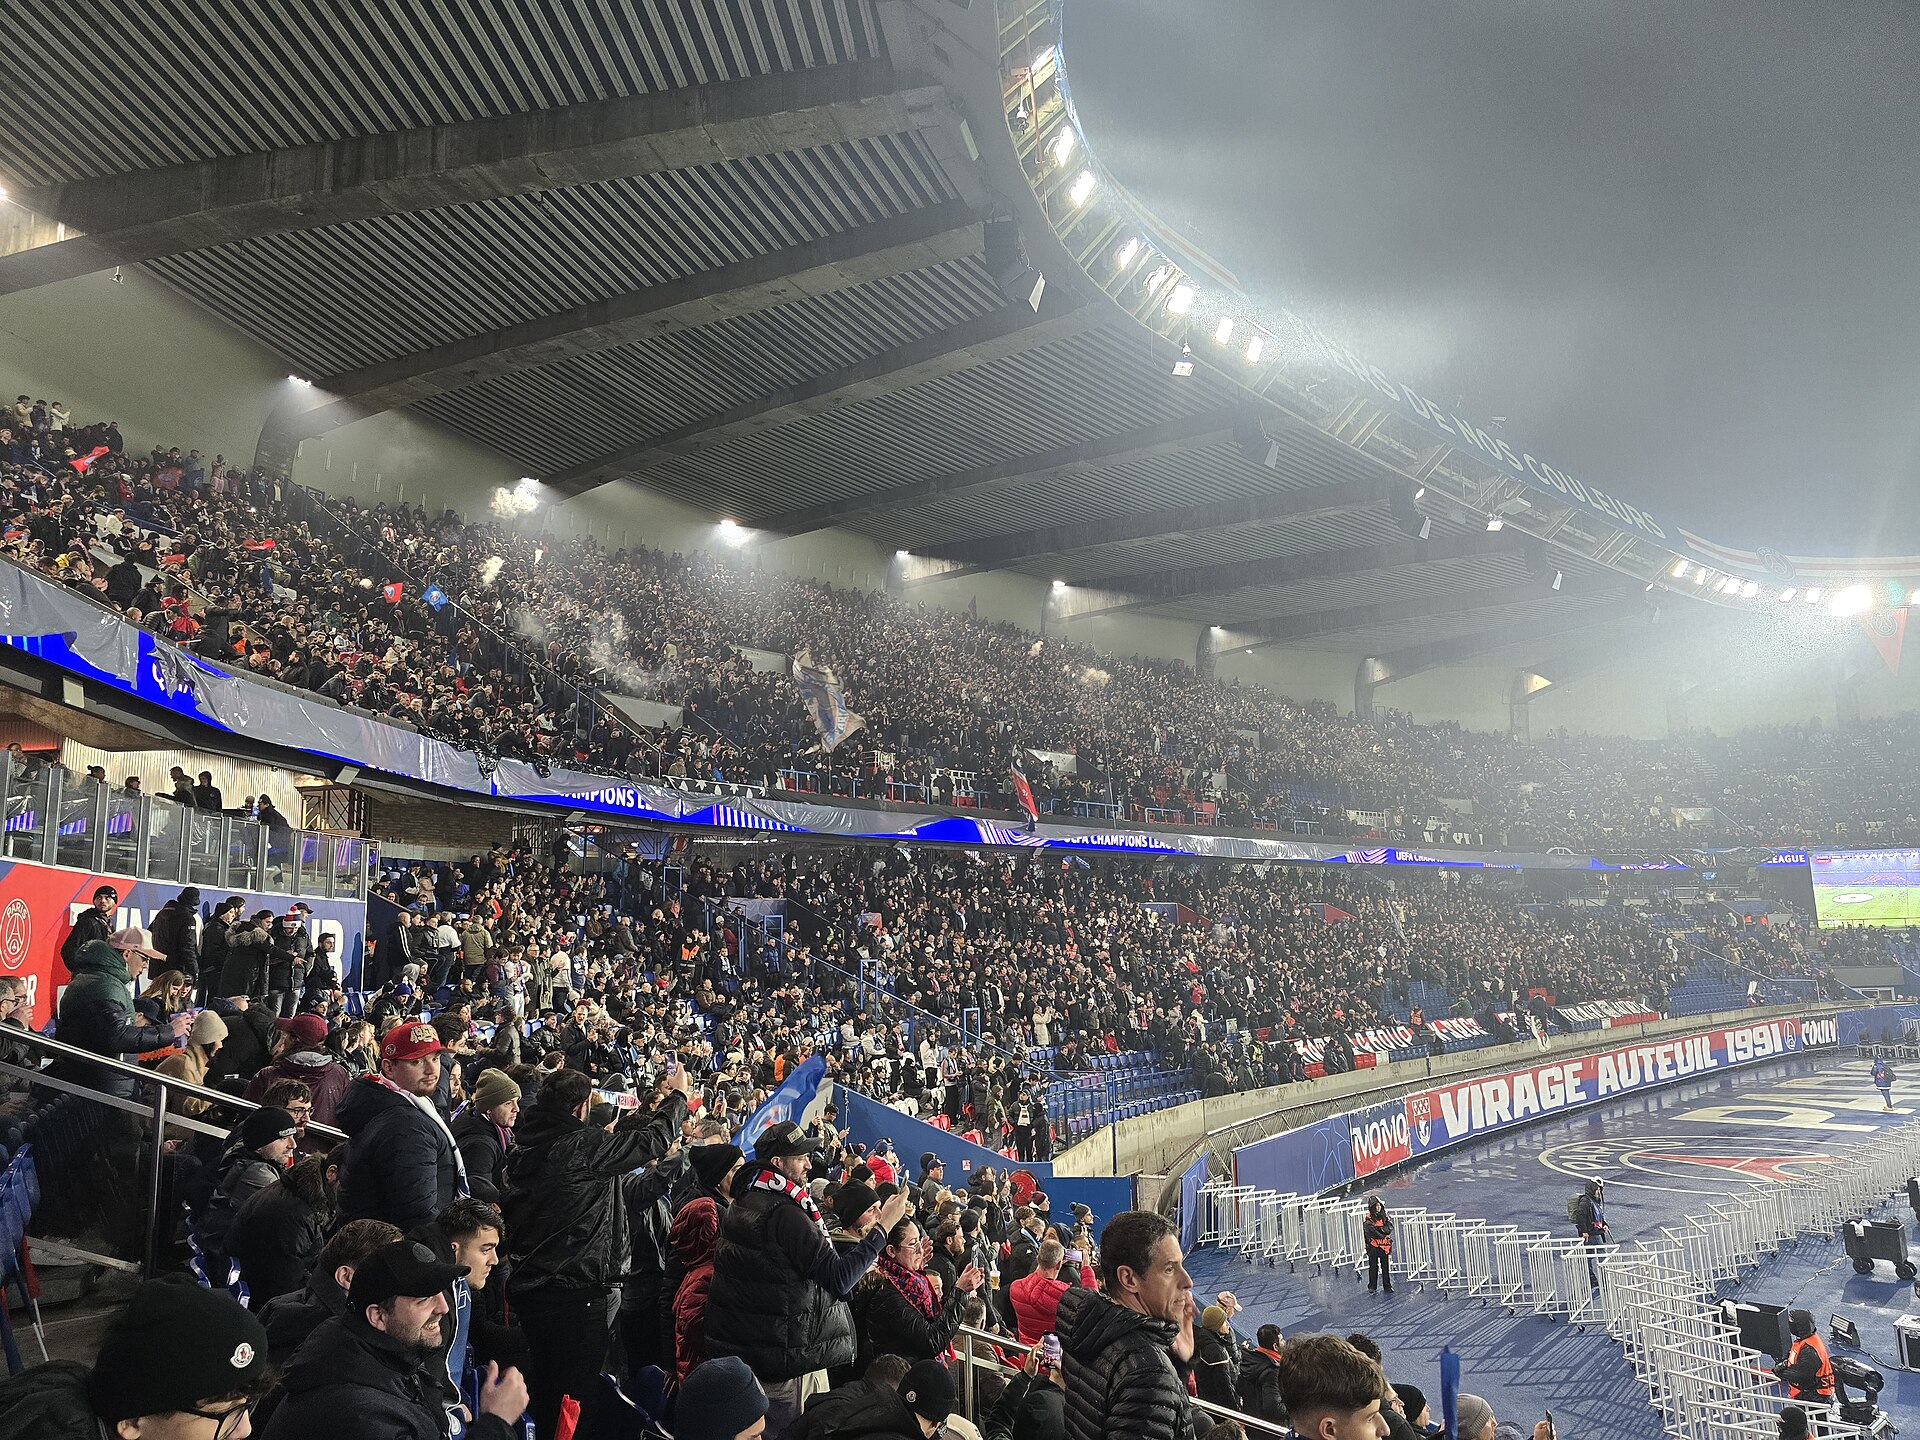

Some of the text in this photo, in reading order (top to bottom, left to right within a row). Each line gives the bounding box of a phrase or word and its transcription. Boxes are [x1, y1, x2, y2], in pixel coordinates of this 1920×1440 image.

[1398, 381, 1457, 436] DE
[1449, 412, 1525, 472] NOS
[1522, 453, 1667, 540] COULEURS
[1090, 834, 1148, 848] CHAMPIONS
[1396, 852, 1413, 861] UEFA
[6, 901, 29, 919] PARIS
[1439, 1024, 1783, 1140] VIRAGE AUTEUIL 1991
[1561, 1138, 1686, 1172] PARIS
